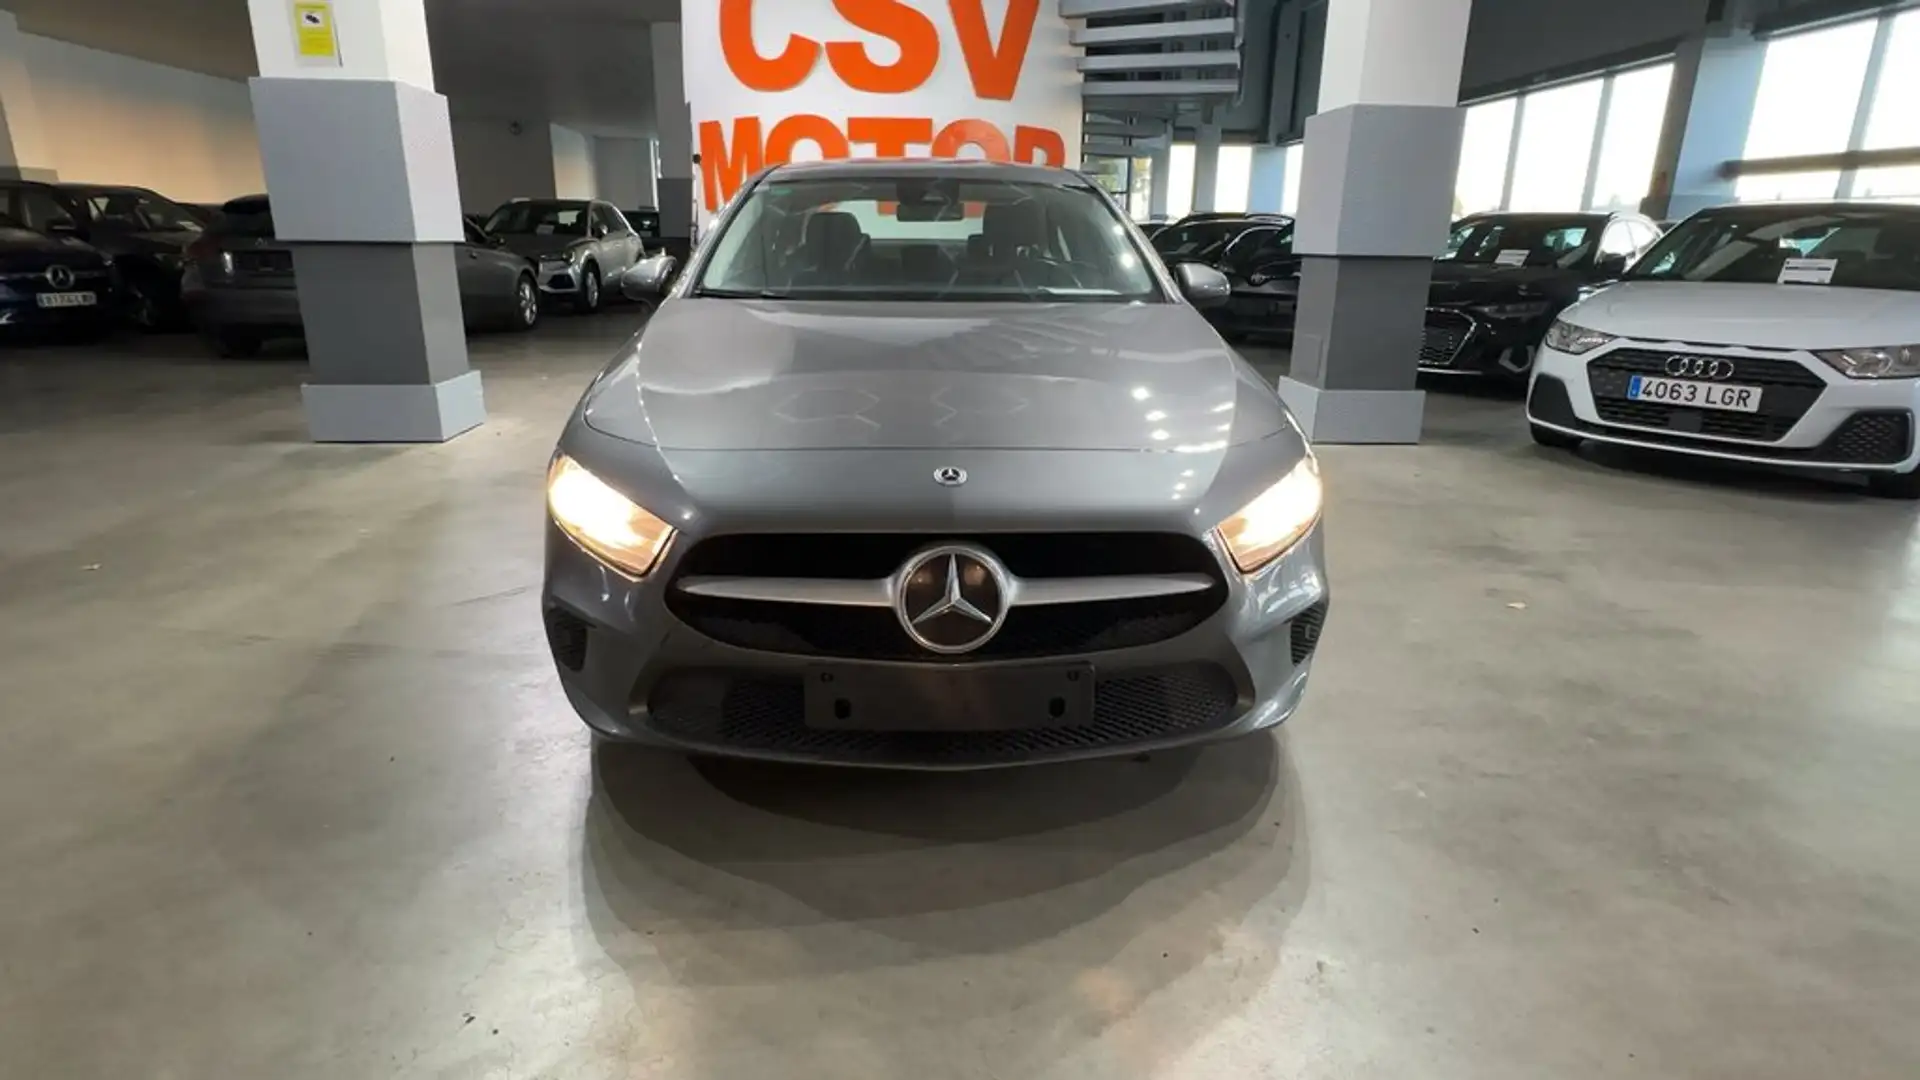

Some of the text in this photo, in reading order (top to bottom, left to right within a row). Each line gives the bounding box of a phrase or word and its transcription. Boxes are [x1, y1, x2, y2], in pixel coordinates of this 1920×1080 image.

[719, 0, 1040, 102] CSV
[1642, 380, 1752, 408] 4063 LGR
